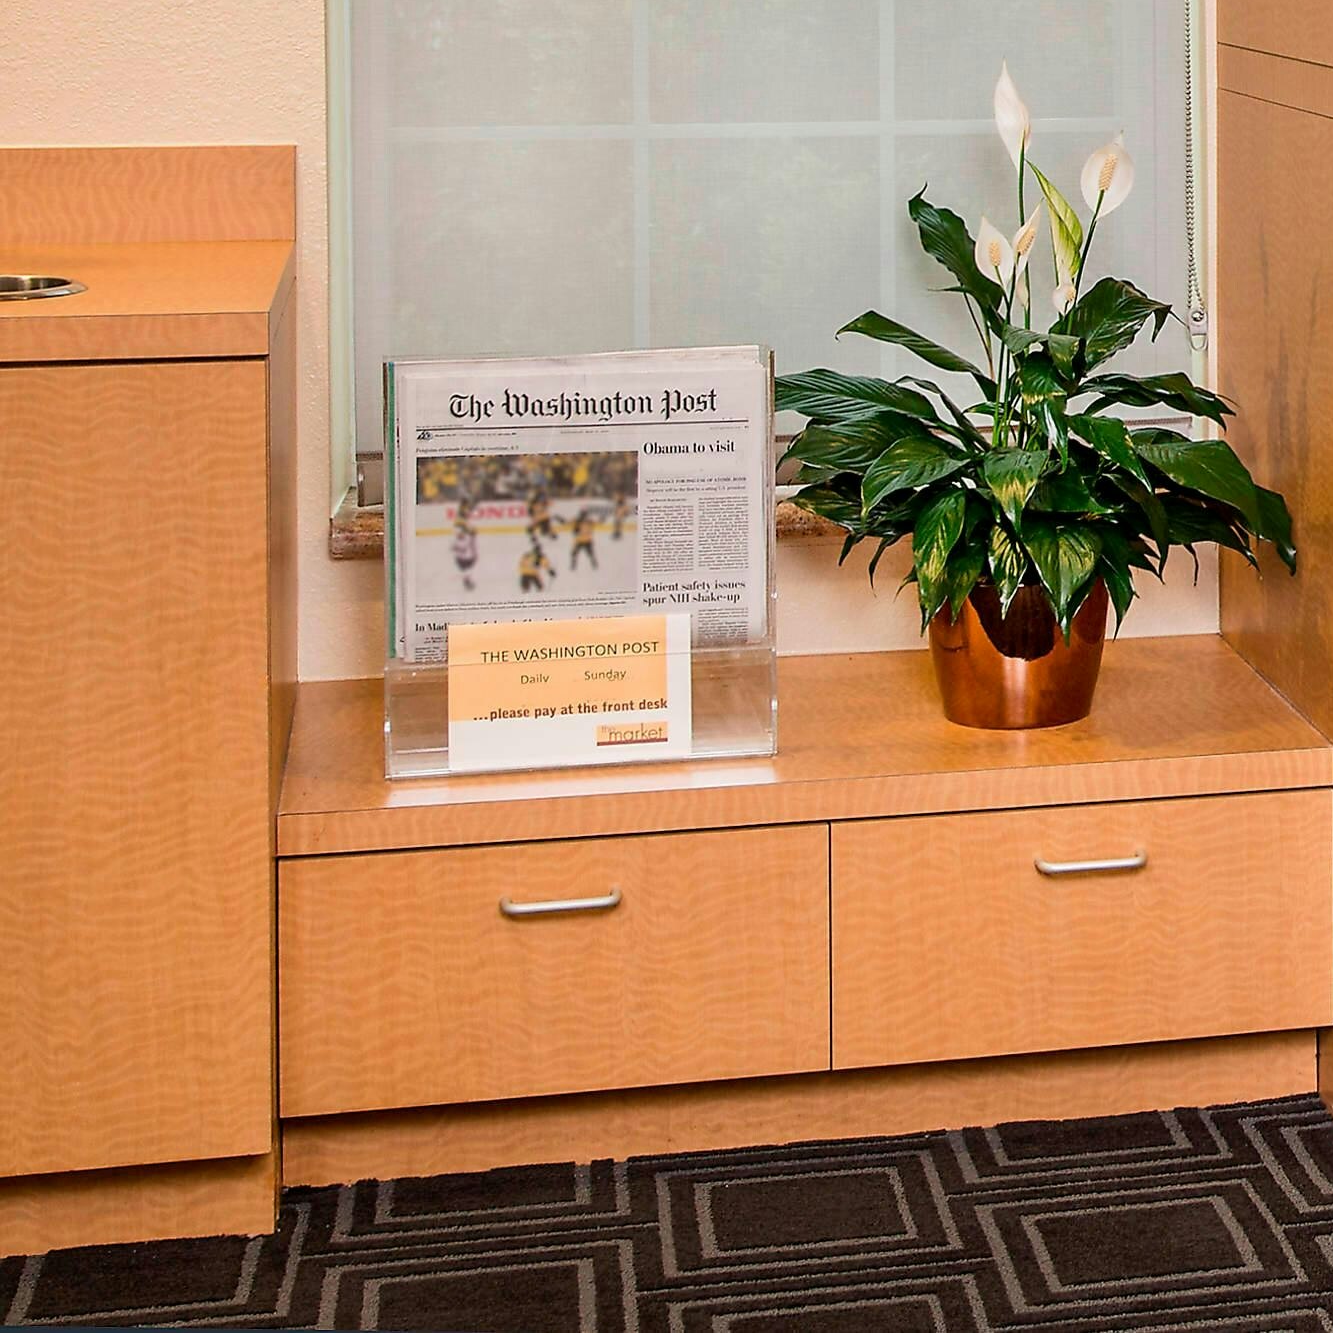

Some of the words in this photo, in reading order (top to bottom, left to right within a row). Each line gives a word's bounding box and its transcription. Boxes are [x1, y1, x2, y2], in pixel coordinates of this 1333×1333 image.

[450, 393, 495, 423] The
[501, 387, 653, 422] Washington
[660, 387, 718, 421] Post
[643, 441, 689, 455] Obama
[692, 442, 706, 454] to
[708, 439, 735, 454] visit
[643, 581, 679, 594] Patient
[682, 580, 710, 594] safety
[714, 579, 746, 591] issues
[643, 594, 667, 607] spur
[692, 591, 741, 606] shake-up
[480, 650, 509, 664] THE
[513, 644, 618, 662] WASHINGTON
[622, 640, 660, 655] POST
[584, 669, 627, 682] Sunday
[534, 705, 557, 719] pay
[560, 704, 575, 716] at
[577, 700, 598, 714] the
[602, 699, 635, 714] front
[639, 697, 668, 711] desk
[608, 723, 664, 743] market
